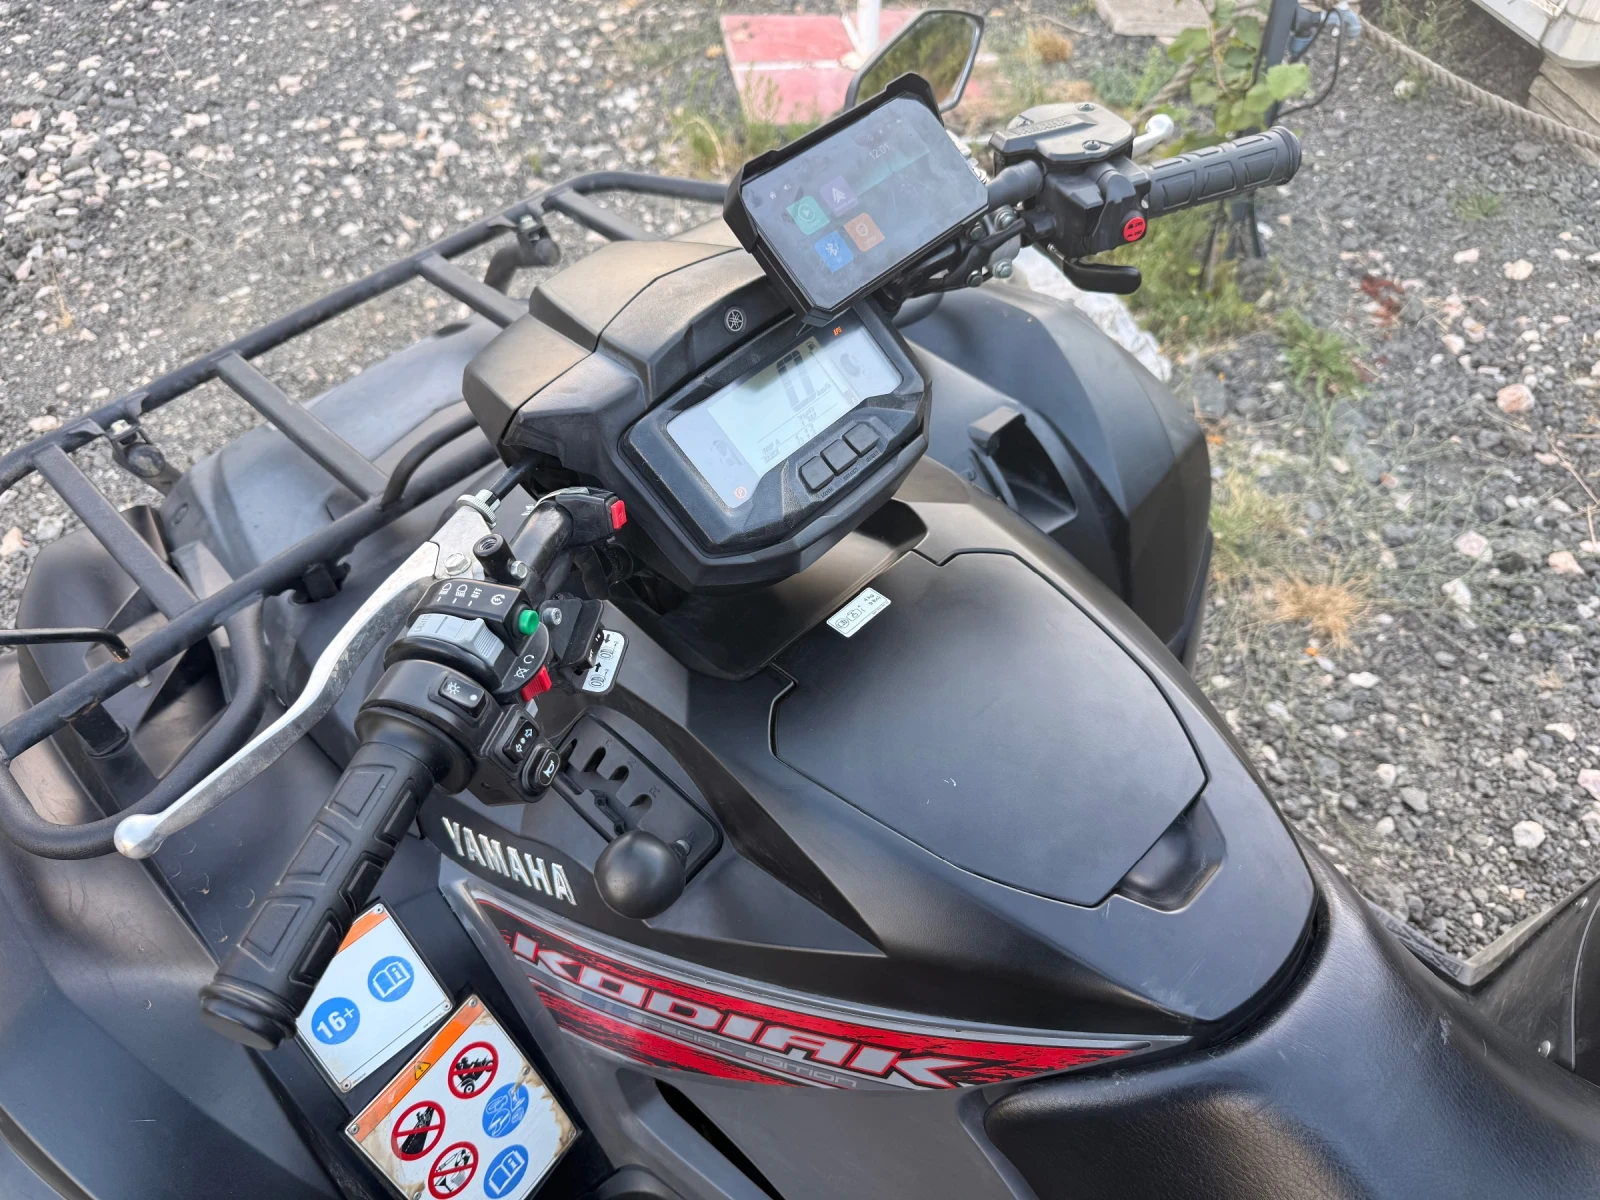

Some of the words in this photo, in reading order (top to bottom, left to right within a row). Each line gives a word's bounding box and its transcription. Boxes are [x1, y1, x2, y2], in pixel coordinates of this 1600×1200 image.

[442, 816, 577, 906] YAMAHA
[316, 1007, 355, 1040] 16+
[512, 931, 972, 1091] KODIAK
[627, 1010, 735, 1055] SPECIAL
[744, 1050, 858, 1088] EDITION
